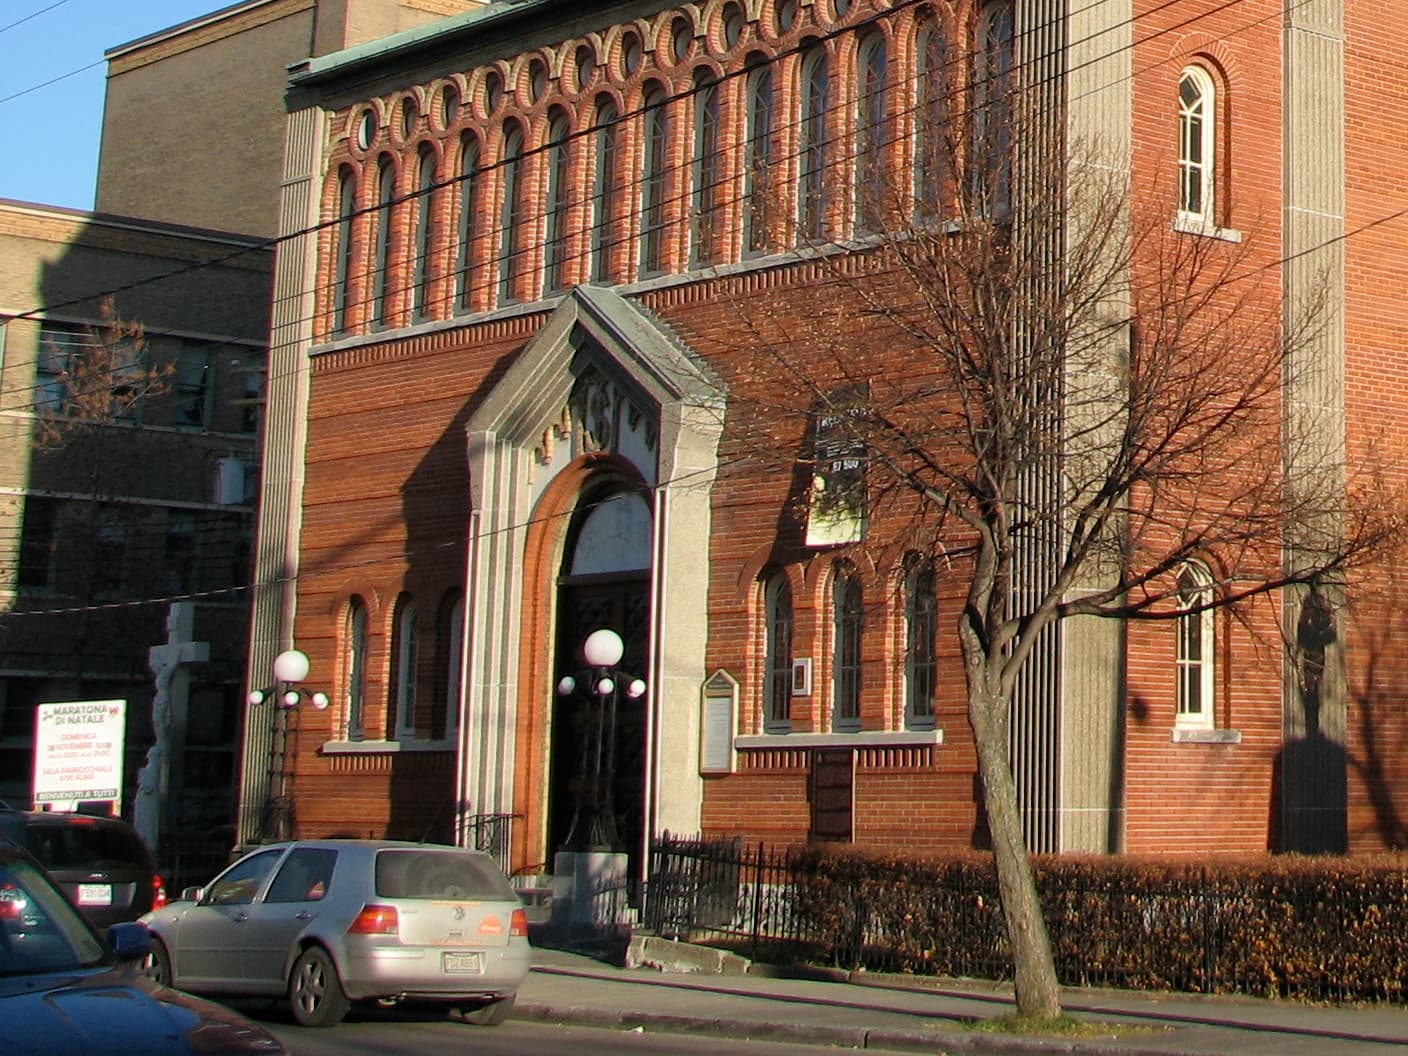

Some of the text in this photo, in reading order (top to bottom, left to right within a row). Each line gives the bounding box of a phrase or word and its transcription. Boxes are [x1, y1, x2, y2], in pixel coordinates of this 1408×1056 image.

[53, 705, 107, 715] MARATONA
[56, 715, 104, 725] DI NATALE
[60, 732, 97, 741] DOMENICA
